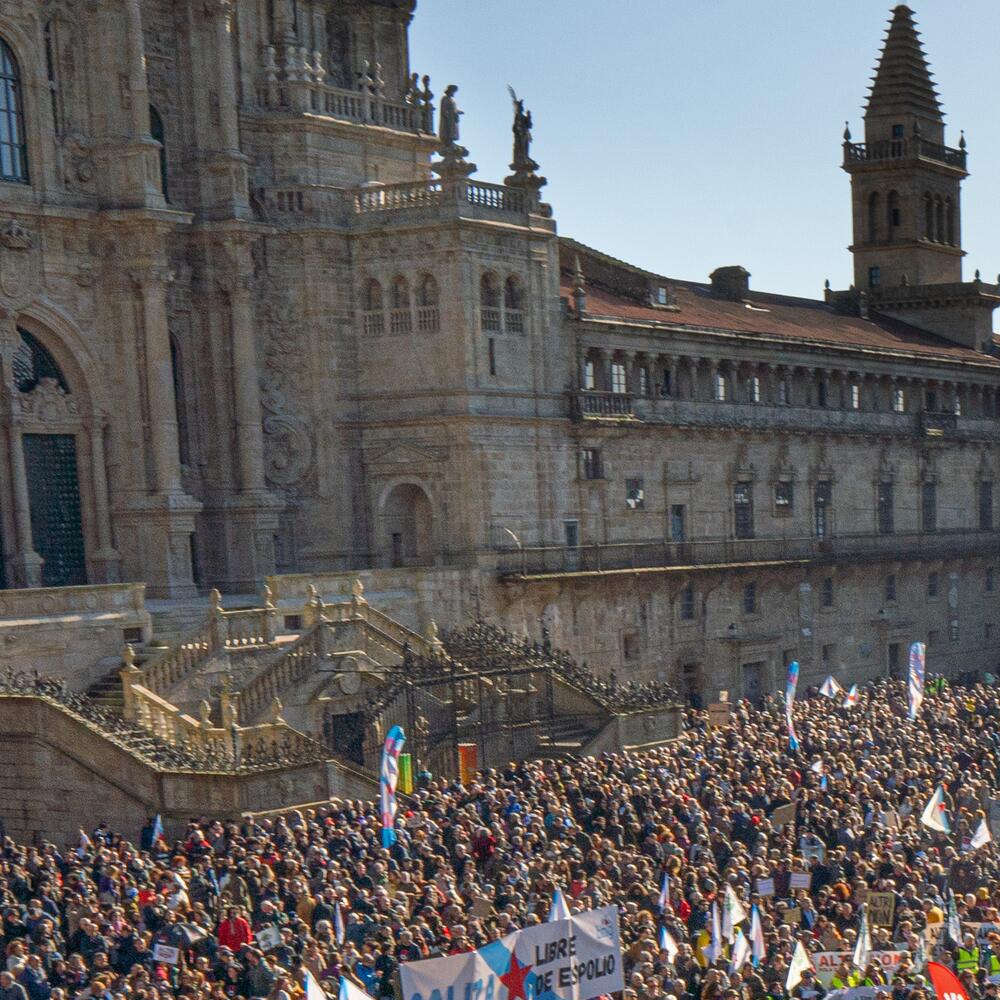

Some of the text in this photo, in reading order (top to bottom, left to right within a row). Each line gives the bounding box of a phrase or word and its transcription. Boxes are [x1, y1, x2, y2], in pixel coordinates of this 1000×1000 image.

[535, 935, 576, 966] LIBRE
[536, 954, 616, 996] DE ESPOLIO
